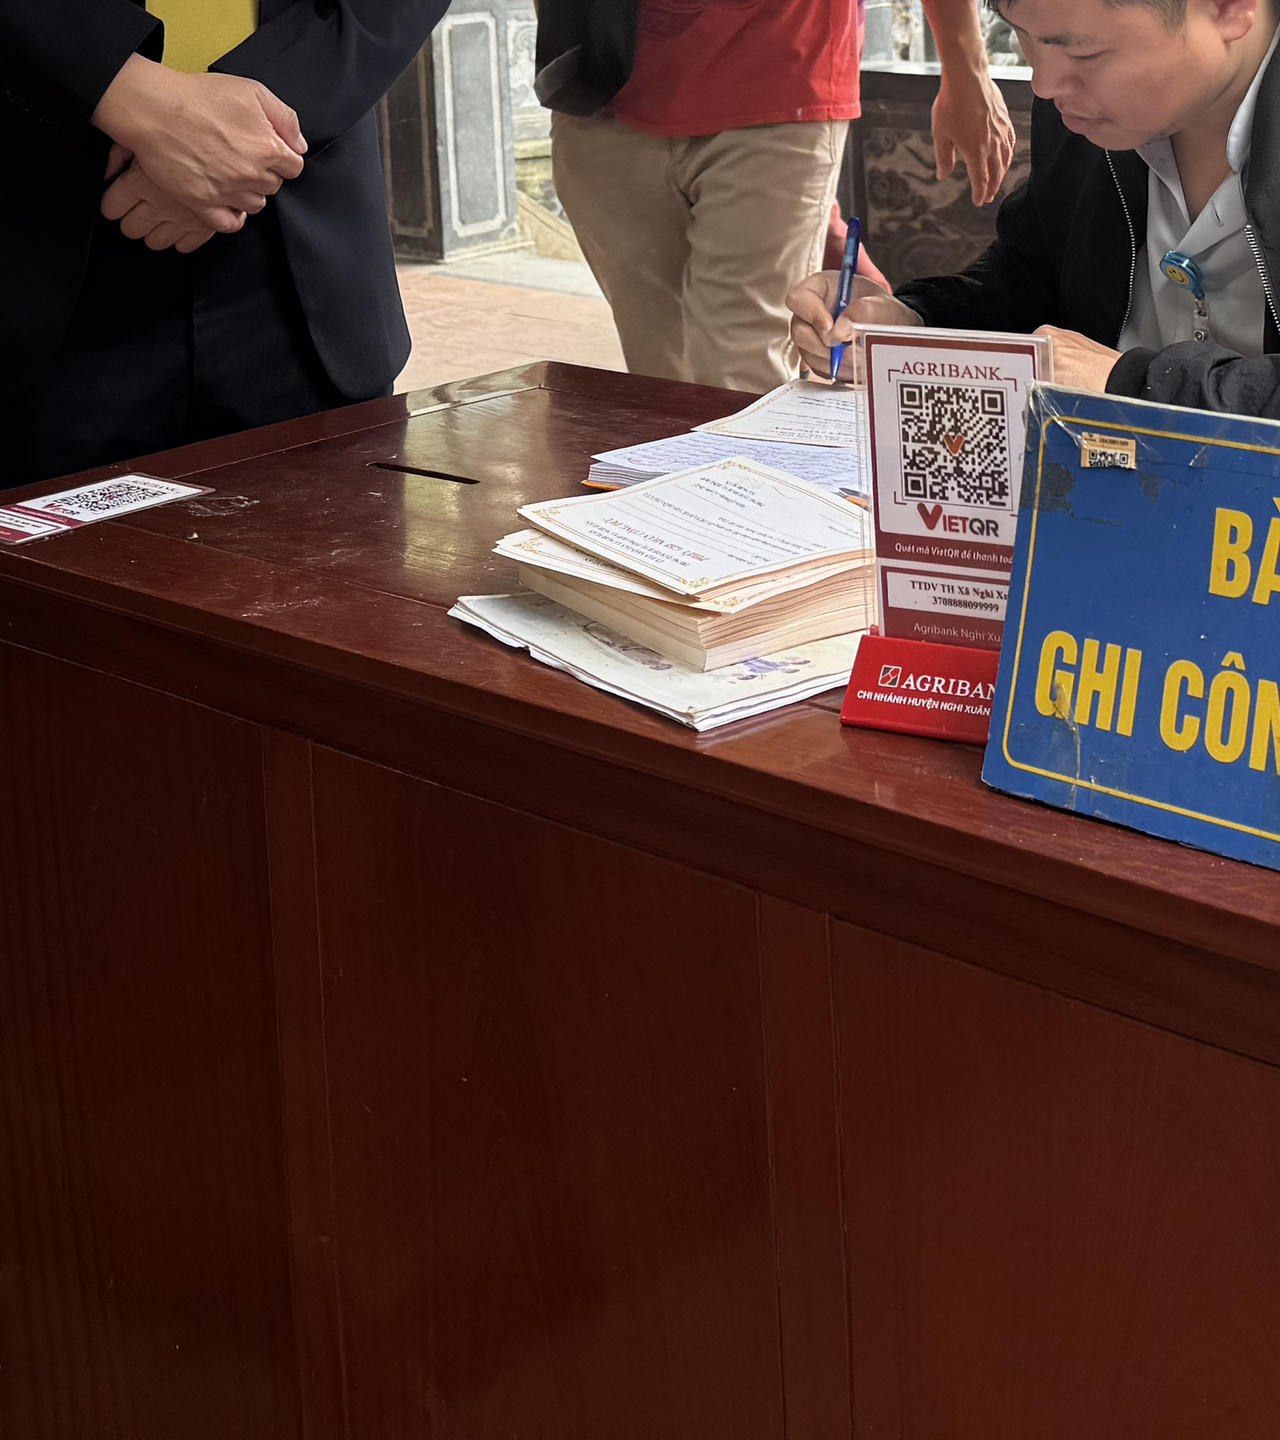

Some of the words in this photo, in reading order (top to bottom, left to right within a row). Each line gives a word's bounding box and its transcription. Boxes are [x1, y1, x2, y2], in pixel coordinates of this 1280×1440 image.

[901, 361, 1003, 381] AGRIBANK
[895, 542, 915, 554] Quét
[931, 547, 960, 558] VietQR
[972, 551, 999, 562] thanh
[910, 580, 938, 591] TTDV
[940, 584, 955, 594] TH
[957, 585, 970, 596] Xã
[972, 588, 994, 600] Nghi
[914, 622, 959, 636] Agribank
[961, 629, 985, 641] Nghi
[1035, 630, 1142, 738] GHI
[857, 690, 873, 700] CHI
[873, 691, 907, 705] NHÁNH
[907, 695, 939, 711] HUYỆN
[940, 701, 963, 712] NGHI
[964, 705, 991, 716] XUÂN
